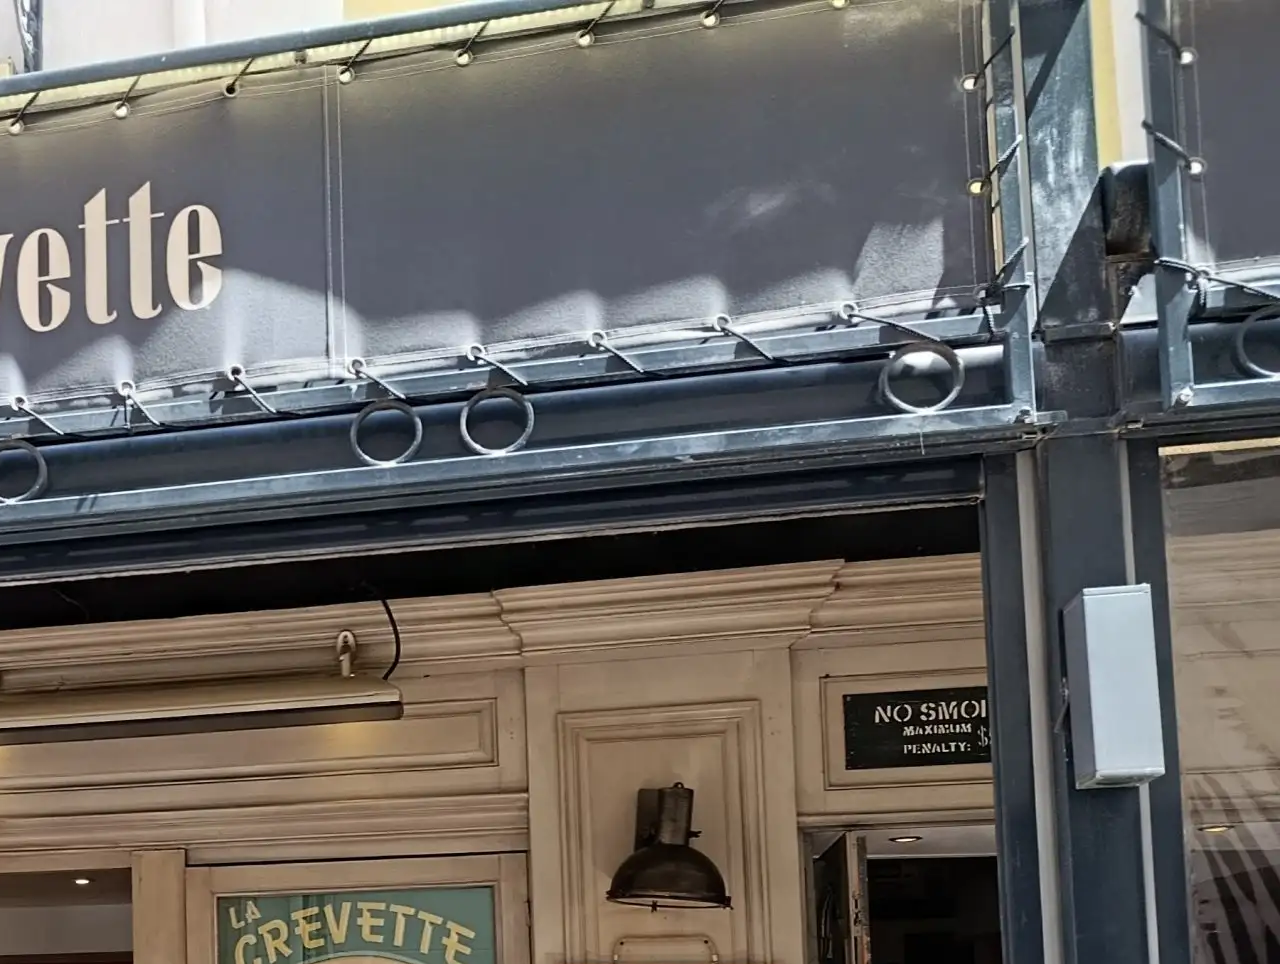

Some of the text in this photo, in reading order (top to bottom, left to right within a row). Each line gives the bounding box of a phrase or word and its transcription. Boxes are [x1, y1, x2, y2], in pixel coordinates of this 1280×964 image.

[874, 704, 912, 723] NO
[903, 723, 972, 736] MAXIMUM
[903, 742, 971, 754] PENALTY:
[229, 900, 261, 930] LA
